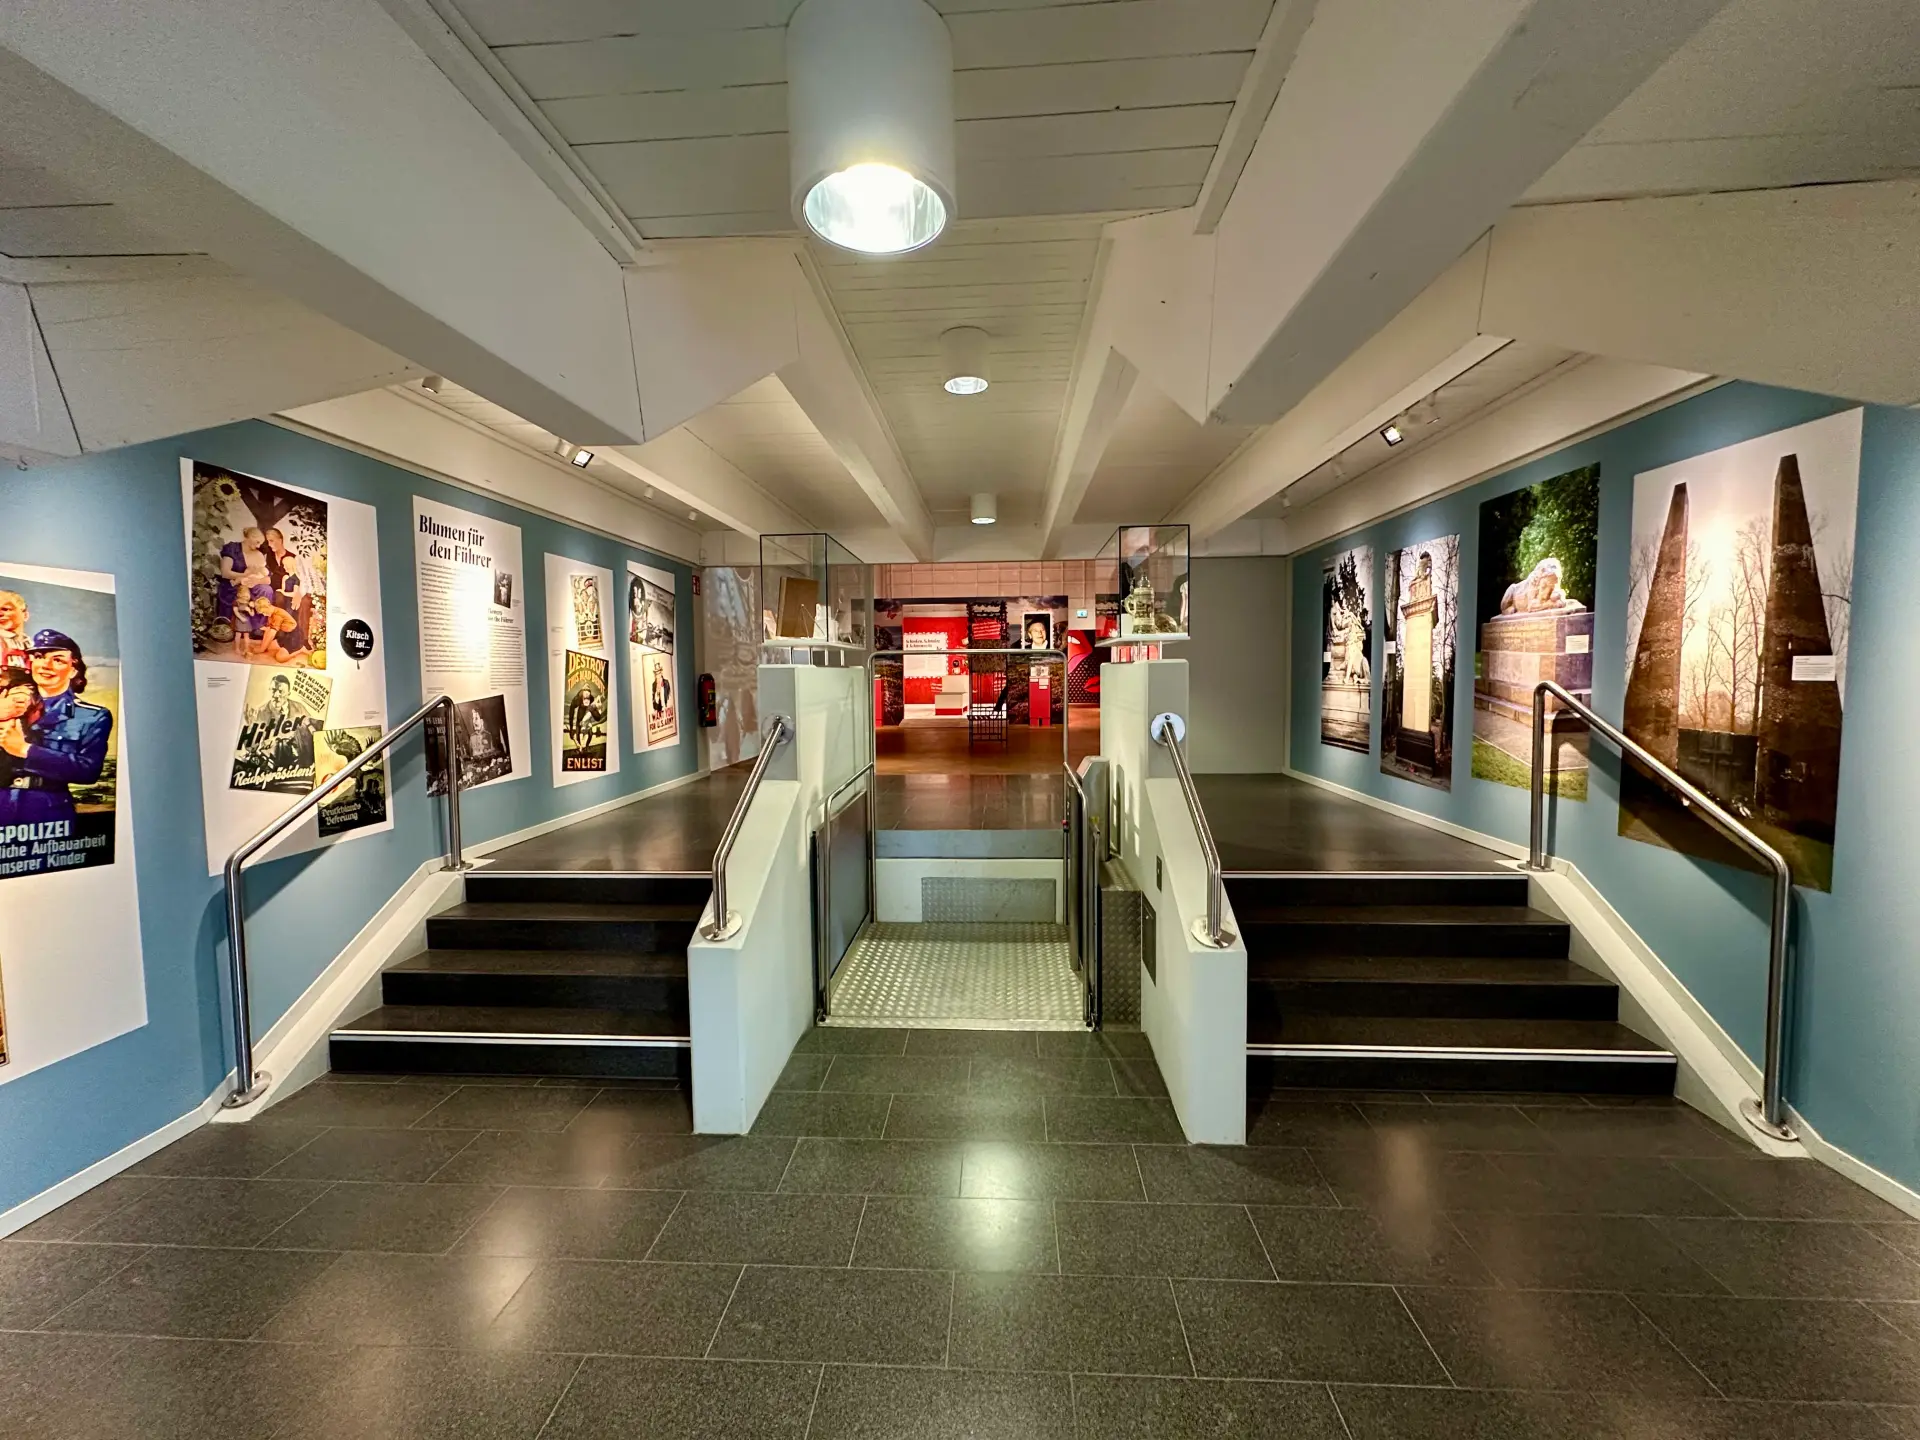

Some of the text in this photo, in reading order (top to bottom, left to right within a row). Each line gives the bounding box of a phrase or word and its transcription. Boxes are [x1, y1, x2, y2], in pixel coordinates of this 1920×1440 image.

[419, 514, 485, 548] Blumen für
[429, 540, 492, 569] den Führer
[345, 629, 370, 641] Kitsch
[568, 652, 607, 682] DESTROY
[305, 686, 324, 705] NATION
[236, 713, 307, 752] Hitler
[567, 757, 604, 770] ENLIST
[232, 761, 316, 790] Reichspräsident
[324, 812, 360, 826] Befreiung
[31, 834, 107, 856] Aufbauarbeit
[47, 852, 87, 868] Kinder
